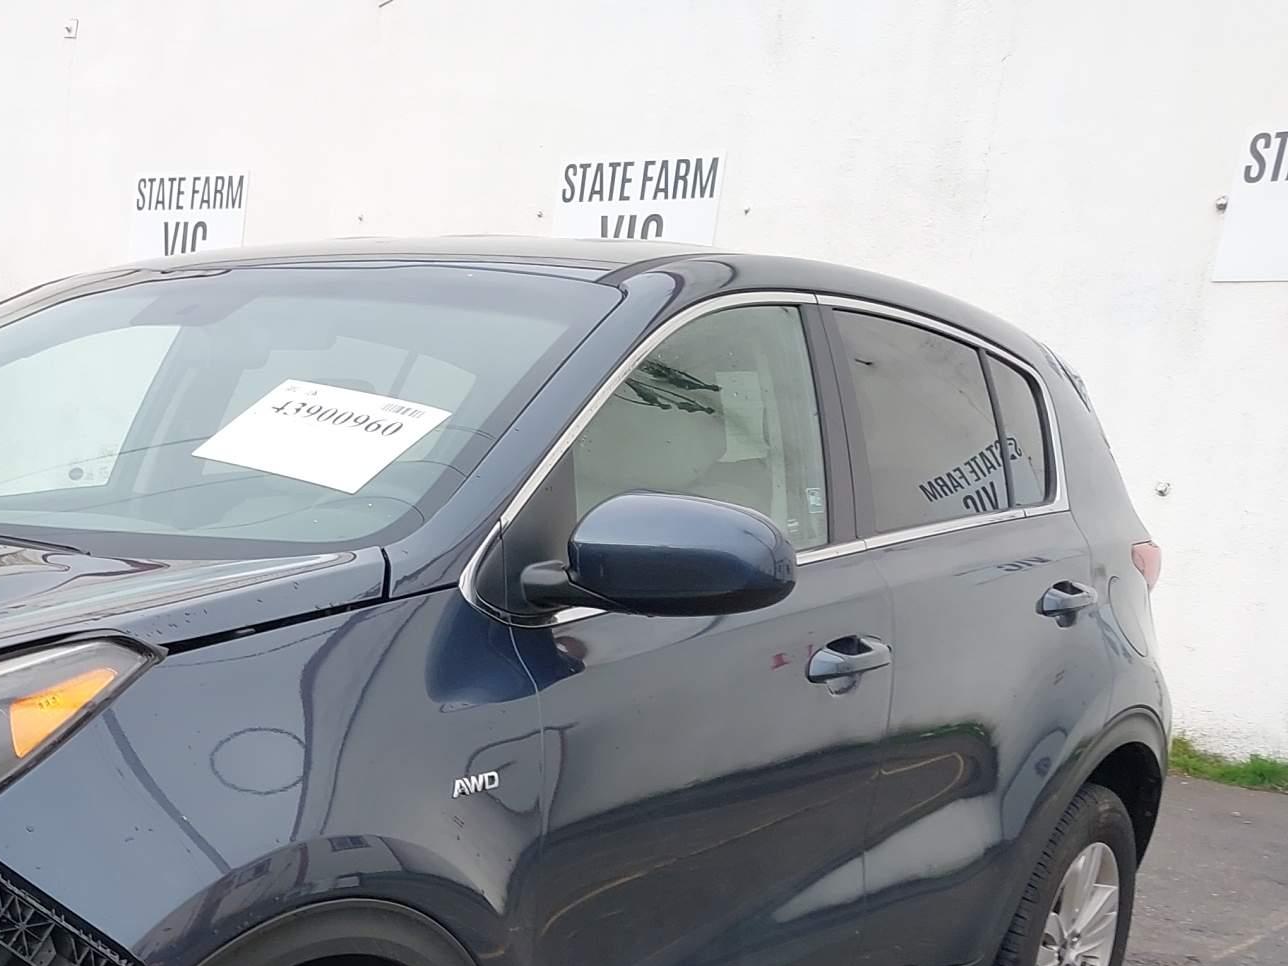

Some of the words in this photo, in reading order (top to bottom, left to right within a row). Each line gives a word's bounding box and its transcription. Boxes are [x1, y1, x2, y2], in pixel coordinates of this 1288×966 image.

[1243, 131, 1288, 183] ST
[136, 177, 186, 211] STATE
[190, 175, 244, 210] FARM
[562, 162, 634, 203] STATE
[639, 157, 719, 200] FARM
[272, 400, 404, 437] 43900960
[453, 770, 499, 798] AWD
